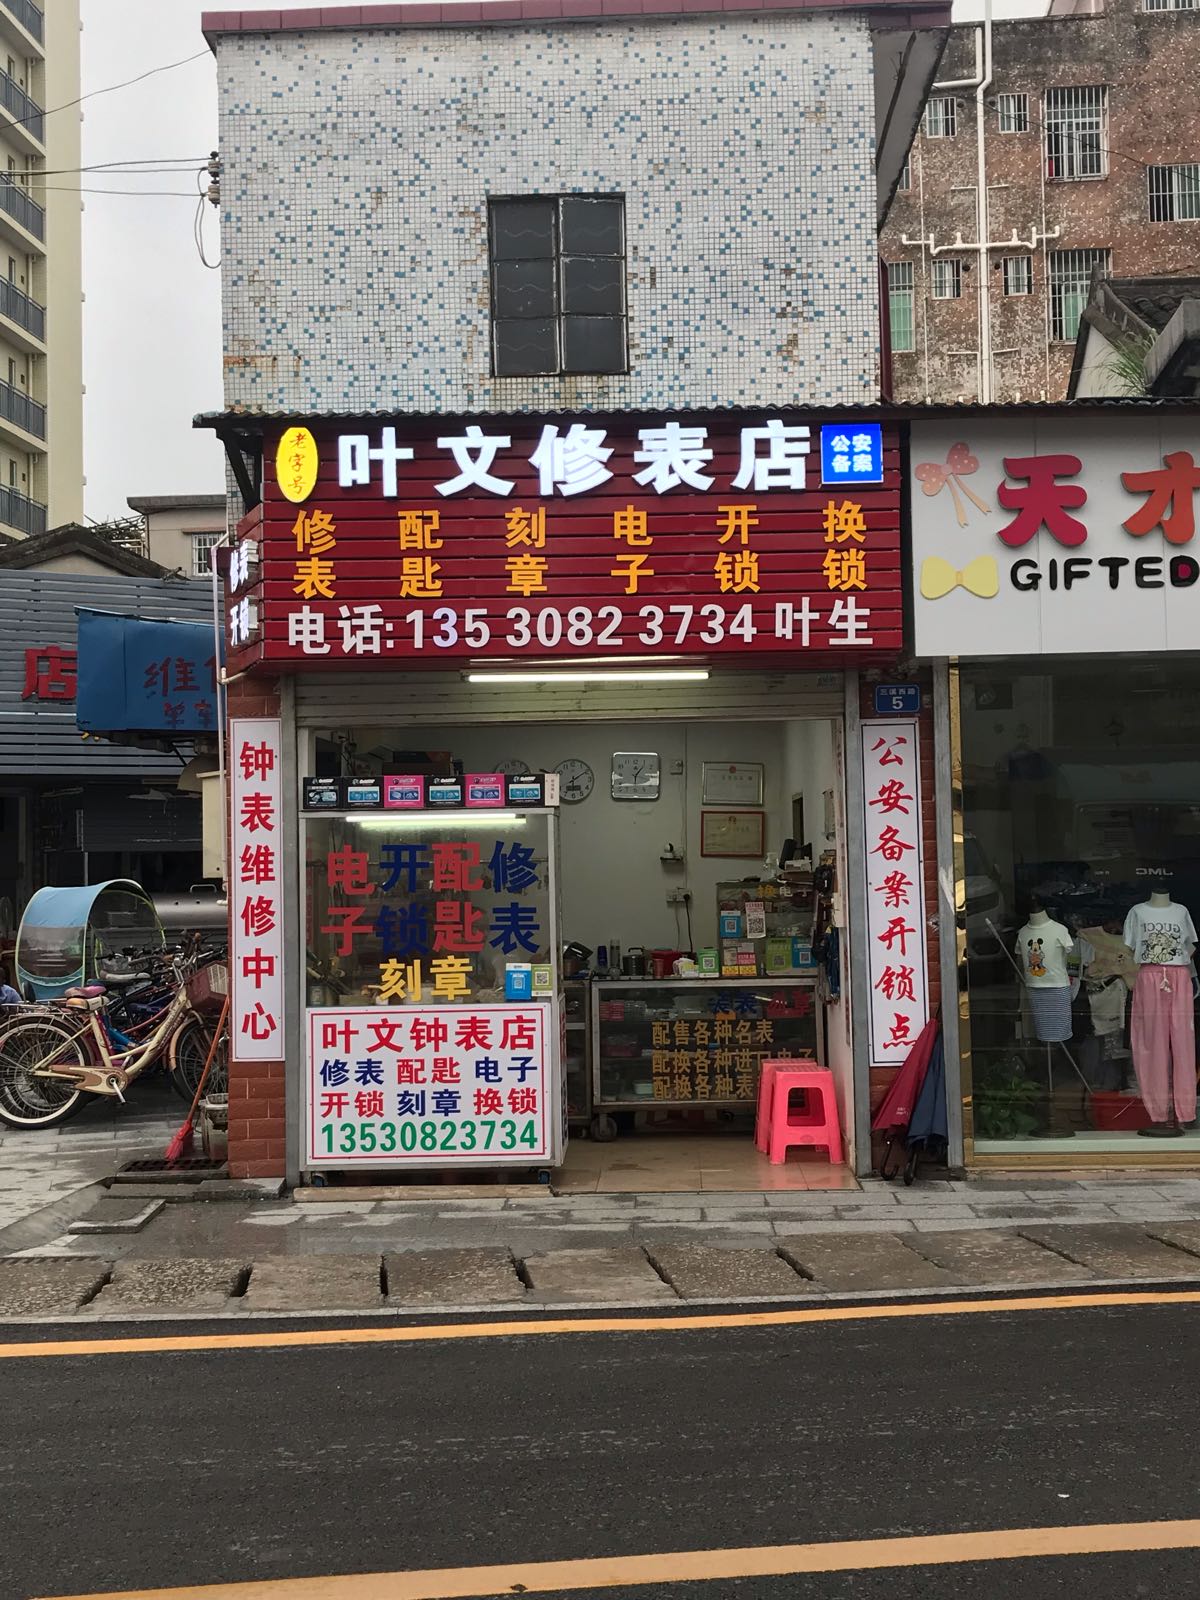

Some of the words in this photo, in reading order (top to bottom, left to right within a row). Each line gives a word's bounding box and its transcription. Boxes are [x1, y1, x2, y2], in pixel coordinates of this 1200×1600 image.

[339, 420, 810, 498] 叶文修表店
[831, 433, 872, 452] 公安
[288, 433, 307, 495] 老字号
[831, 453, 873, 472] 备案
[997, 451, 1200, 547] 天才
[1010, 555, 1200, 591] GIFTED
[506, 607, 624, 648] 3082
[638, 603, 757, 645] 3734
[775, 597, 873, 647] 叶生
[892, 696, 903, 709] 5
[239, 741, 277, 1040] 钟表维修中心
[868, 736, 917, 1049] 公安备案开锁点
[379, 955, 473, 1001] 刻章
[322, 1015, 537, 1054] 叶文钟表店
[651, 1018, 775, 1046] 配售各种名表
[320, 1058, 385, 1087] 修表
[396, 1057, 461, 1085] 配匙
[475, 1056, 538, 1083] 电子
[652, 1074, 755, 1100] 配换各种表
[320, 1091, 385, 1118] 开锁
[396, 1089, 461, 1117] 刻章
[473, 1088, 538, 1116] 换锁
[321, 1120, 538, 1153] 13530823734
